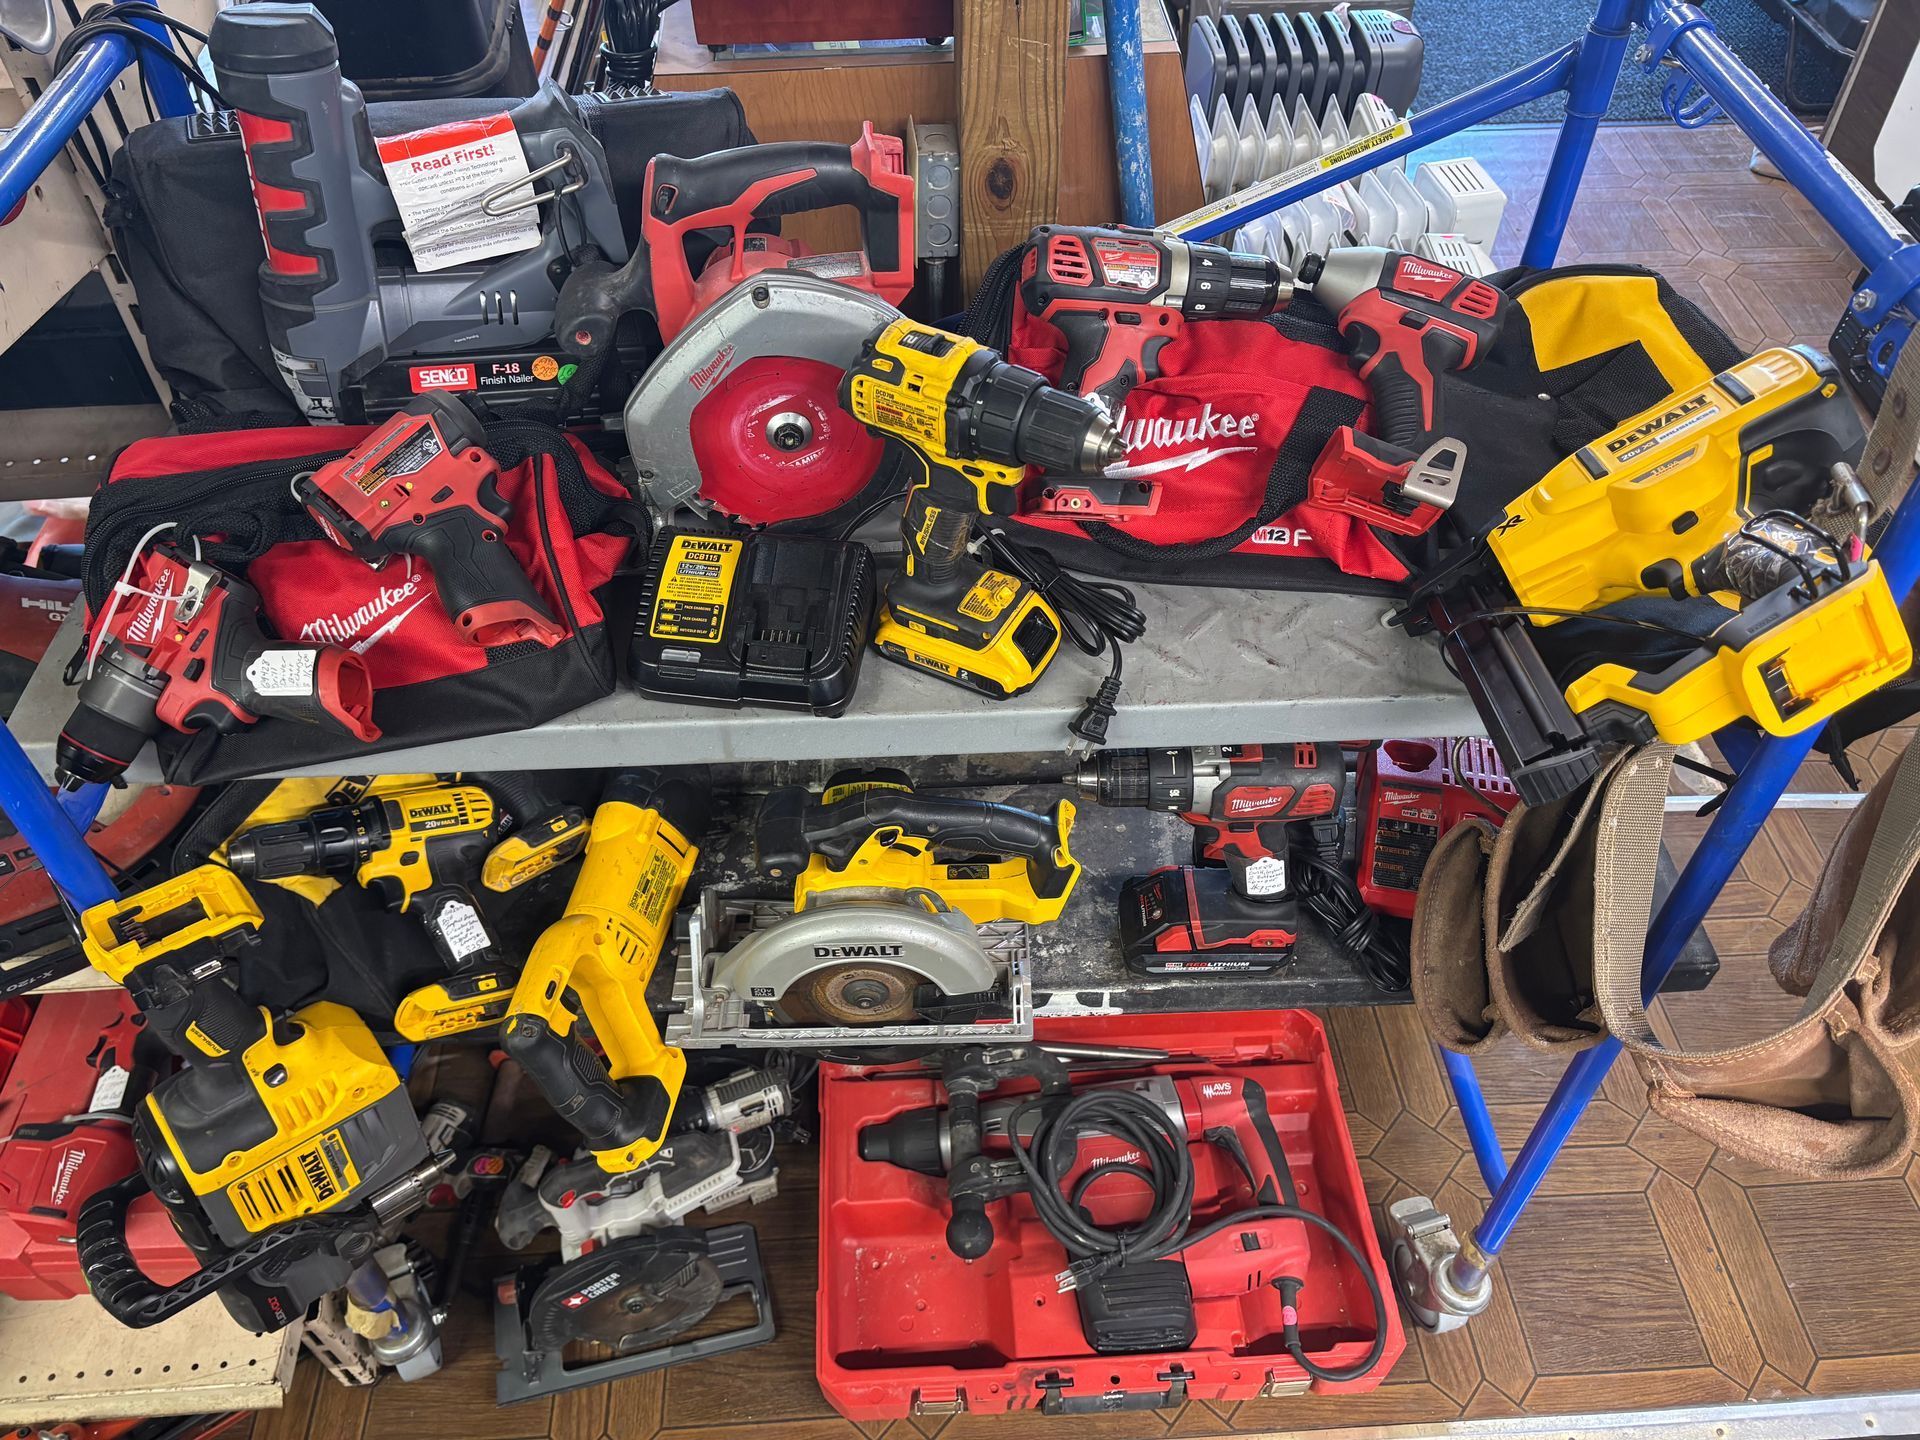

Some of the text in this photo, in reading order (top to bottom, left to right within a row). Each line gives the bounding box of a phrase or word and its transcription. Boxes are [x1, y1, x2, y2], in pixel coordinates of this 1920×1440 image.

[1372, 133, 1393, 147] SAFETY
[411, 144, 495, 173] Read First!
[1329, 145, 1371, 165] INSTRUCTIONS
[450, 225, 463, 233] Quick
[1202, 258, 1212, 266] 4
[1403, 260, 1453, 280] Milwaukee
[1195, 303, 1205, 311] 8
[419, 367, 468, 384] SENCO
[492, 362, 520, 375] F-18
[689, 343, 735, 391] Milwaukee
[480, 374, 534, 385] Finish Nailer
[1606, 394, 1707, 453] DEWALT
[1621, 449, 1641, 461] 20V
[1660, 408, 1717, 441] BRUSHLESS
[919, 509, 937, 546] BRUSHLESS
[681, 540, 733, 553] DEWALT
[688, 552, 719, 562] DCB115
[21, 597, 74, 613] HIL
[126, 568, 171, 643] Milwaukee
[301, 580, 416, 644] Milwaukee
[914, 653, 950, 674] DEWALT
[1231, 795, 1282, 811] Milwaukee
[1384, 791, 1420, 801] Milwaukee
[409, 803, 454, 819] DEWALT
[814, 945, 903, 958] DEWALT
[1213, 1082, 1232, 1090] AVS
[55, 1149, 86, 1205] Milwaukee
[301, 1149, 336, 1202] DEWALT
[580, 1272, 621, 1296] PORTER
[587, 1280, 620, 1299] CABLE
